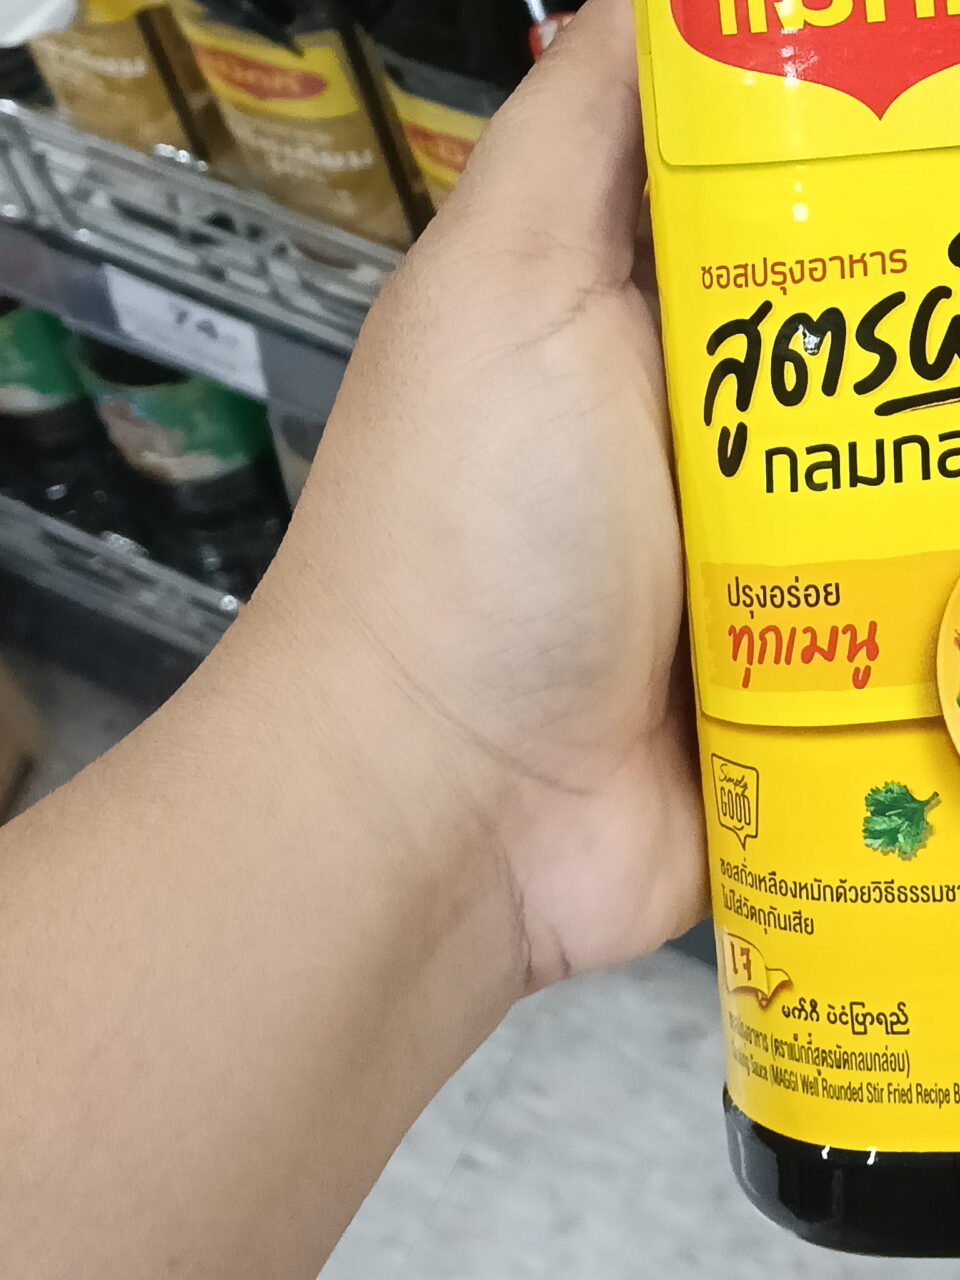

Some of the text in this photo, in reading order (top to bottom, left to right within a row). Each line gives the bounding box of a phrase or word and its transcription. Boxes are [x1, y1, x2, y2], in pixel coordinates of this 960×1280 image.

[700, 246, 909, 297] ซอสปรุงอาหาร
[727, 575, 842, 618] ปรุงอร่อย
[727, 619, 881, 690] ทุกเมนู
[720, 786, 752, 826] GOOD
[800, 1072, 820, 1098] Well
[821, 1077, 864, 1104] Rounded
[866, 1082, 885, 1105] Stir
[887, 1083, 913, 1105] Fried
[915, 1083, 951, 1109] Recipe
